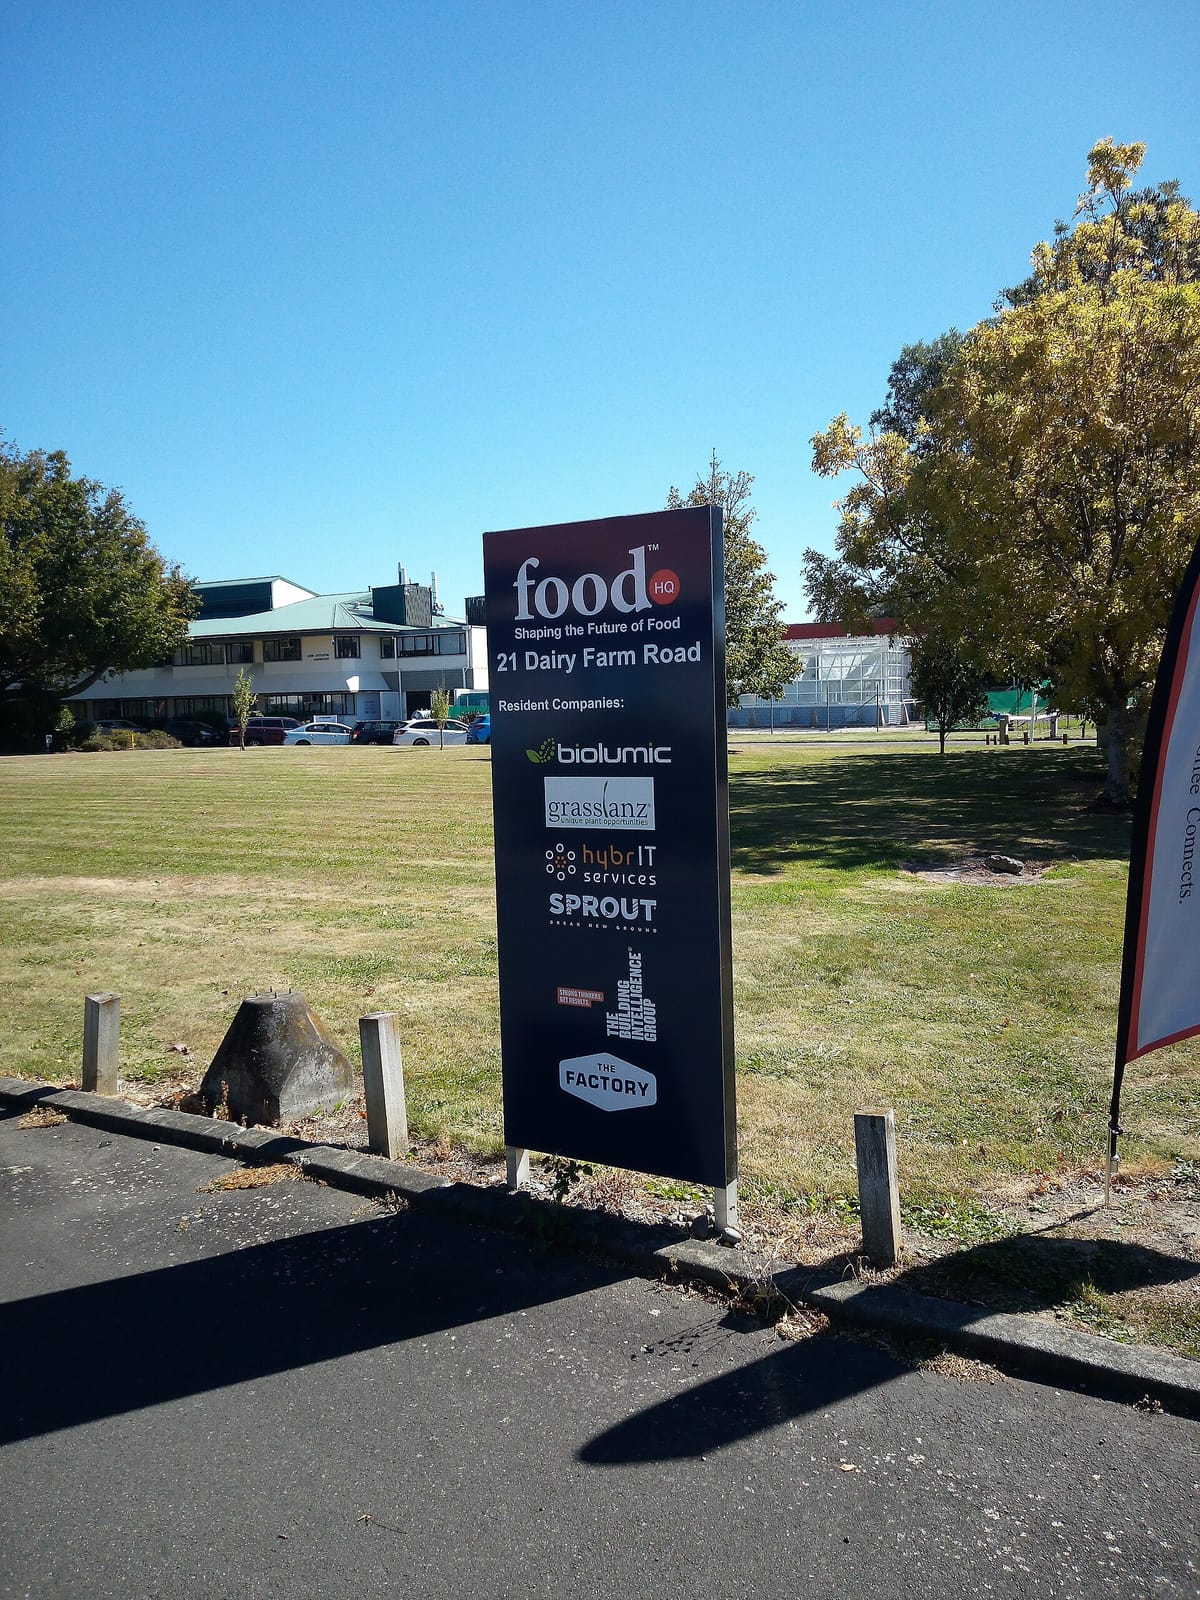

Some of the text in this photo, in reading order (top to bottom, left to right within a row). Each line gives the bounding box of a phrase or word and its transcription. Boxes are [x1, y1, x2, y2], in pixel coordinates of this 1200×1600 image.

[513, 545, 652, 620] food
[654, 580, 675, 594] HQ
[514, 616, 681, 641] Shaping the Future of Food
[497, 641, 701, 674] 21 Dairy Farm Road
[498, 697, 625, 712] Resident Companies:
[557, 742, 672, 763] biolumic
[549, 780, 649, 823] grasslanz
[583, 843, 657, 870] hybrIT
[1179, 807, 1200, 904] Connects.
[583, 872, 657, 885] services
[550, 893, 657, 921] SPROUT
[617, 980, 631, 1039] BUILDING
[629, 952, 644, 1041] INTELLIGENCE
[606, 1012, 619, 1036] THE
[643, 998, 657, 1042] GROUP
[597, 1063, 616, 1073] THE
[566, 1071, 649, 1097] FACTORY
